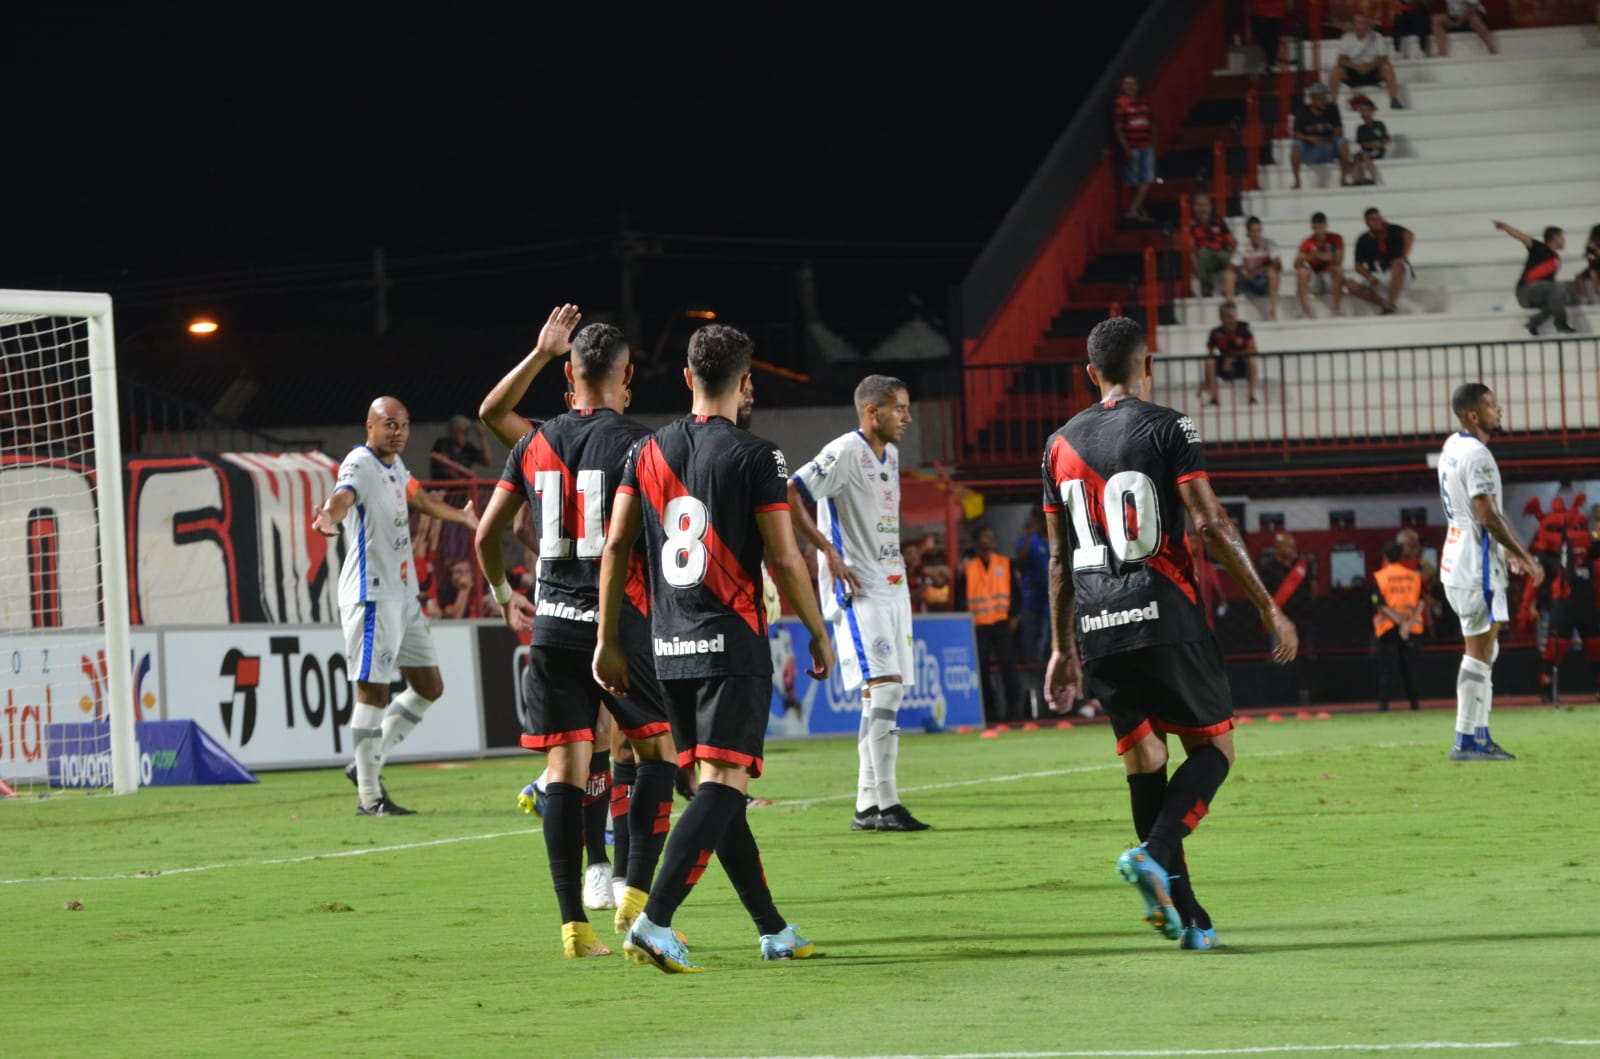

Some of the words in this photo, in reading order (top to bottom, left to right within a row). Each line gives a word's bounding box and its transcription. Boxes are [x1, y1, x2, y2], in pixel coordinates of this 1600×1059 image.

[534, 470, 605, 560] 11
[661, 496, 709, 588] 8
[1060, 470, 1161, 573] 10
[654, 633, 725, 656] Unimed
[1080, 600, 1160, 633] Unimed
